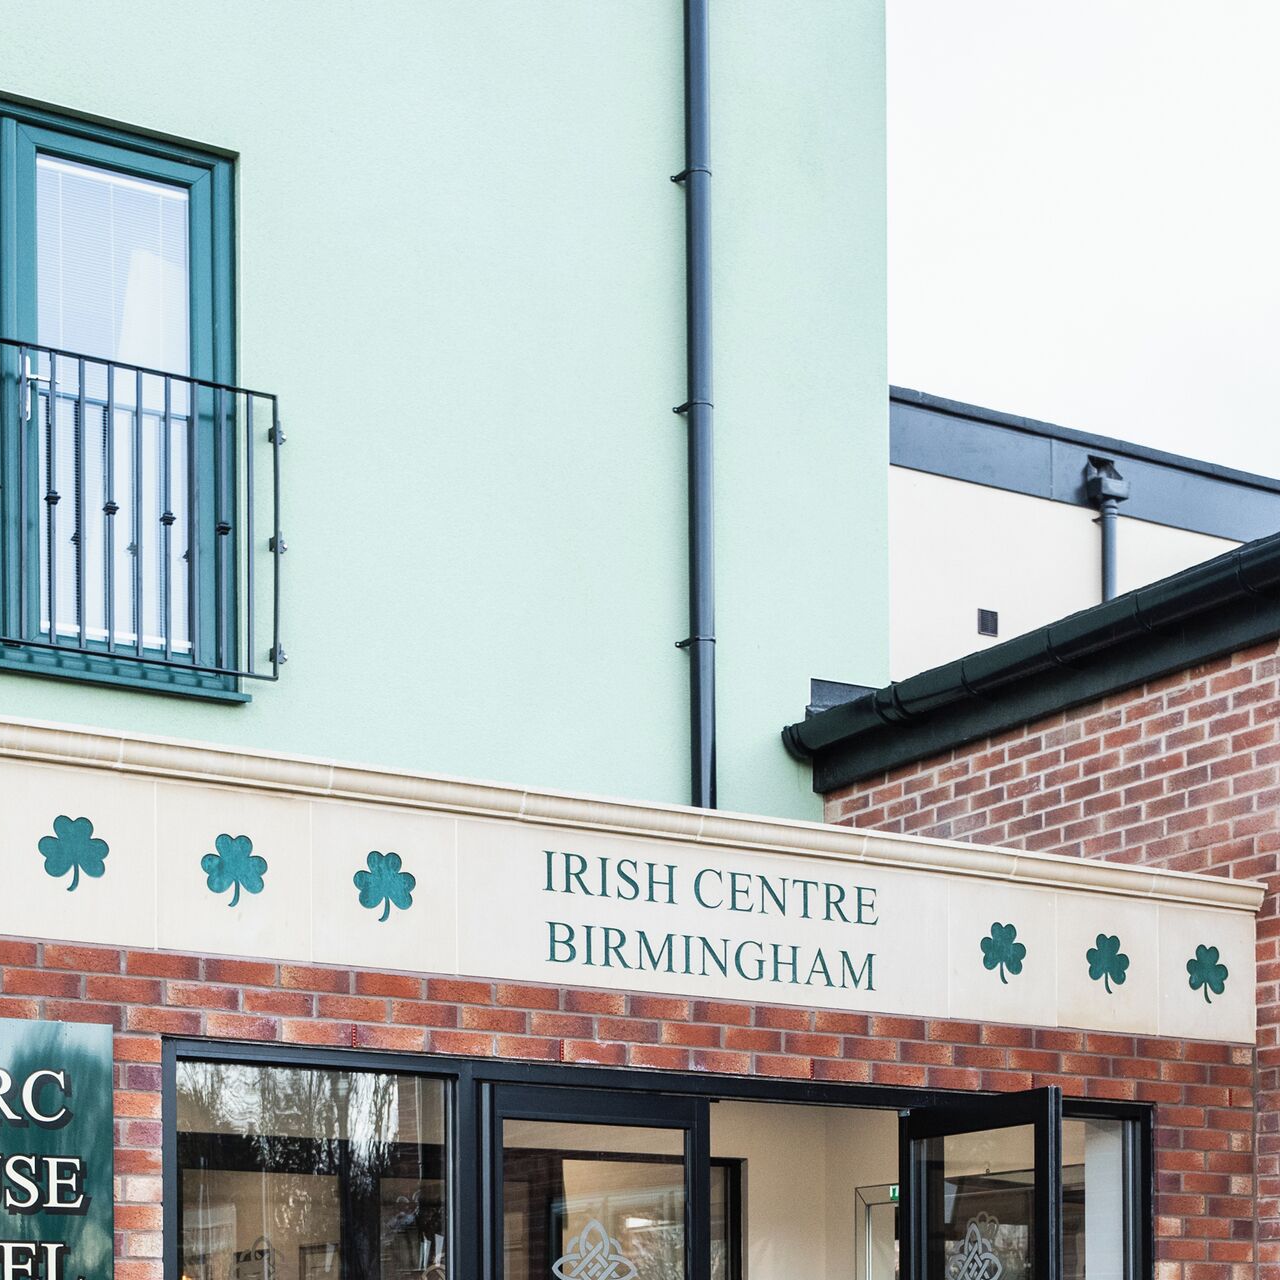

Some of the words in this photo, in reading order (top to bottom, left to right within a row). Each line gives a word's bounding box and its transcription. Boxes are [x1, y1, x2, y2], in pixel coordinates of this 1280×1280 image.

[542, 849, 679, 906] IRISH
[692, 867, 880, 927] CENTRE
[544, 920, 878, 993] BIRMINGHAM
